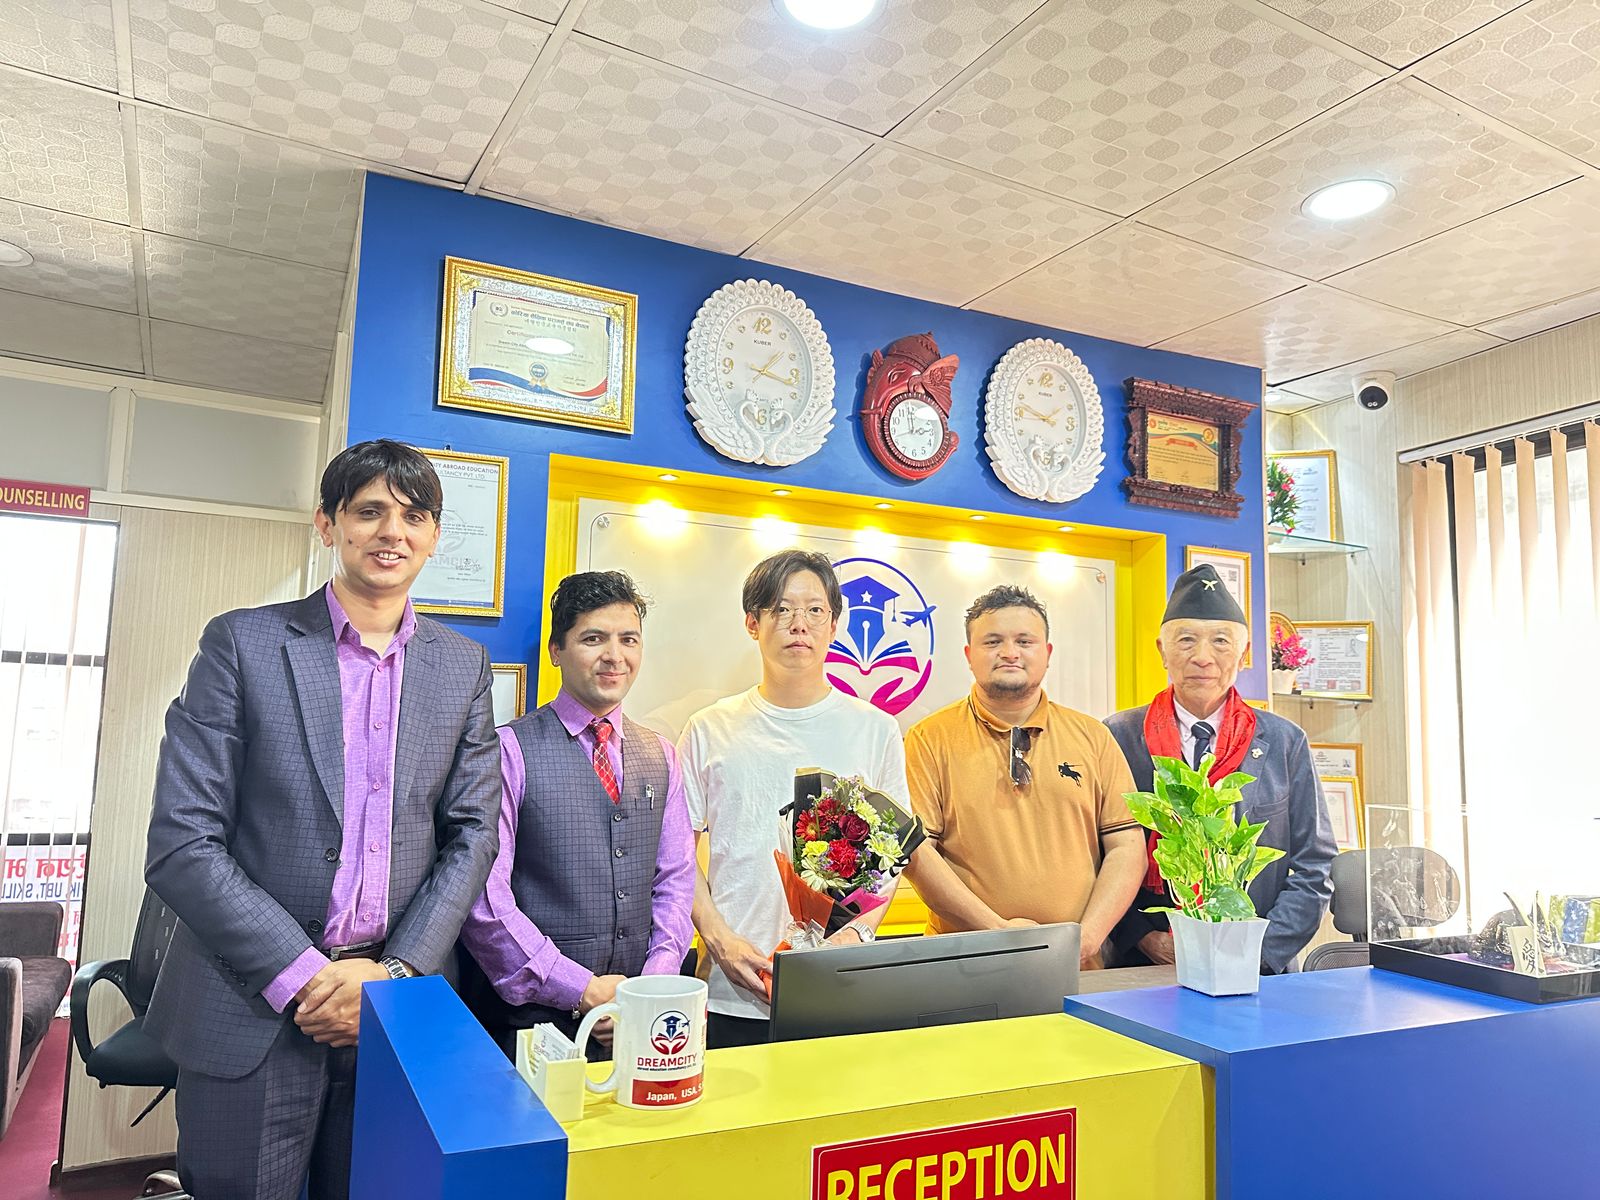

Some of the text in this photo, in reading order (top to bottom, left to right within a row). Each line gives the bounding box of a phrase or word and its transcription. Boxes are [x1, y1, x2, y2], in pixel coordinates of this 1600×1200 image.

[753, 339, 772, 347] KUBER
[443, 463, 466, 472] ABROAD
[467, 466, 498, 475] EDUCATION
[0, 487, 85, 510] UNSELLING
[637, 1053, 697, 1067] DREAMCITY
[646, 1092, 677, 1102] Japan,
[827, 1133, 1066, 1200] RECEPTION
